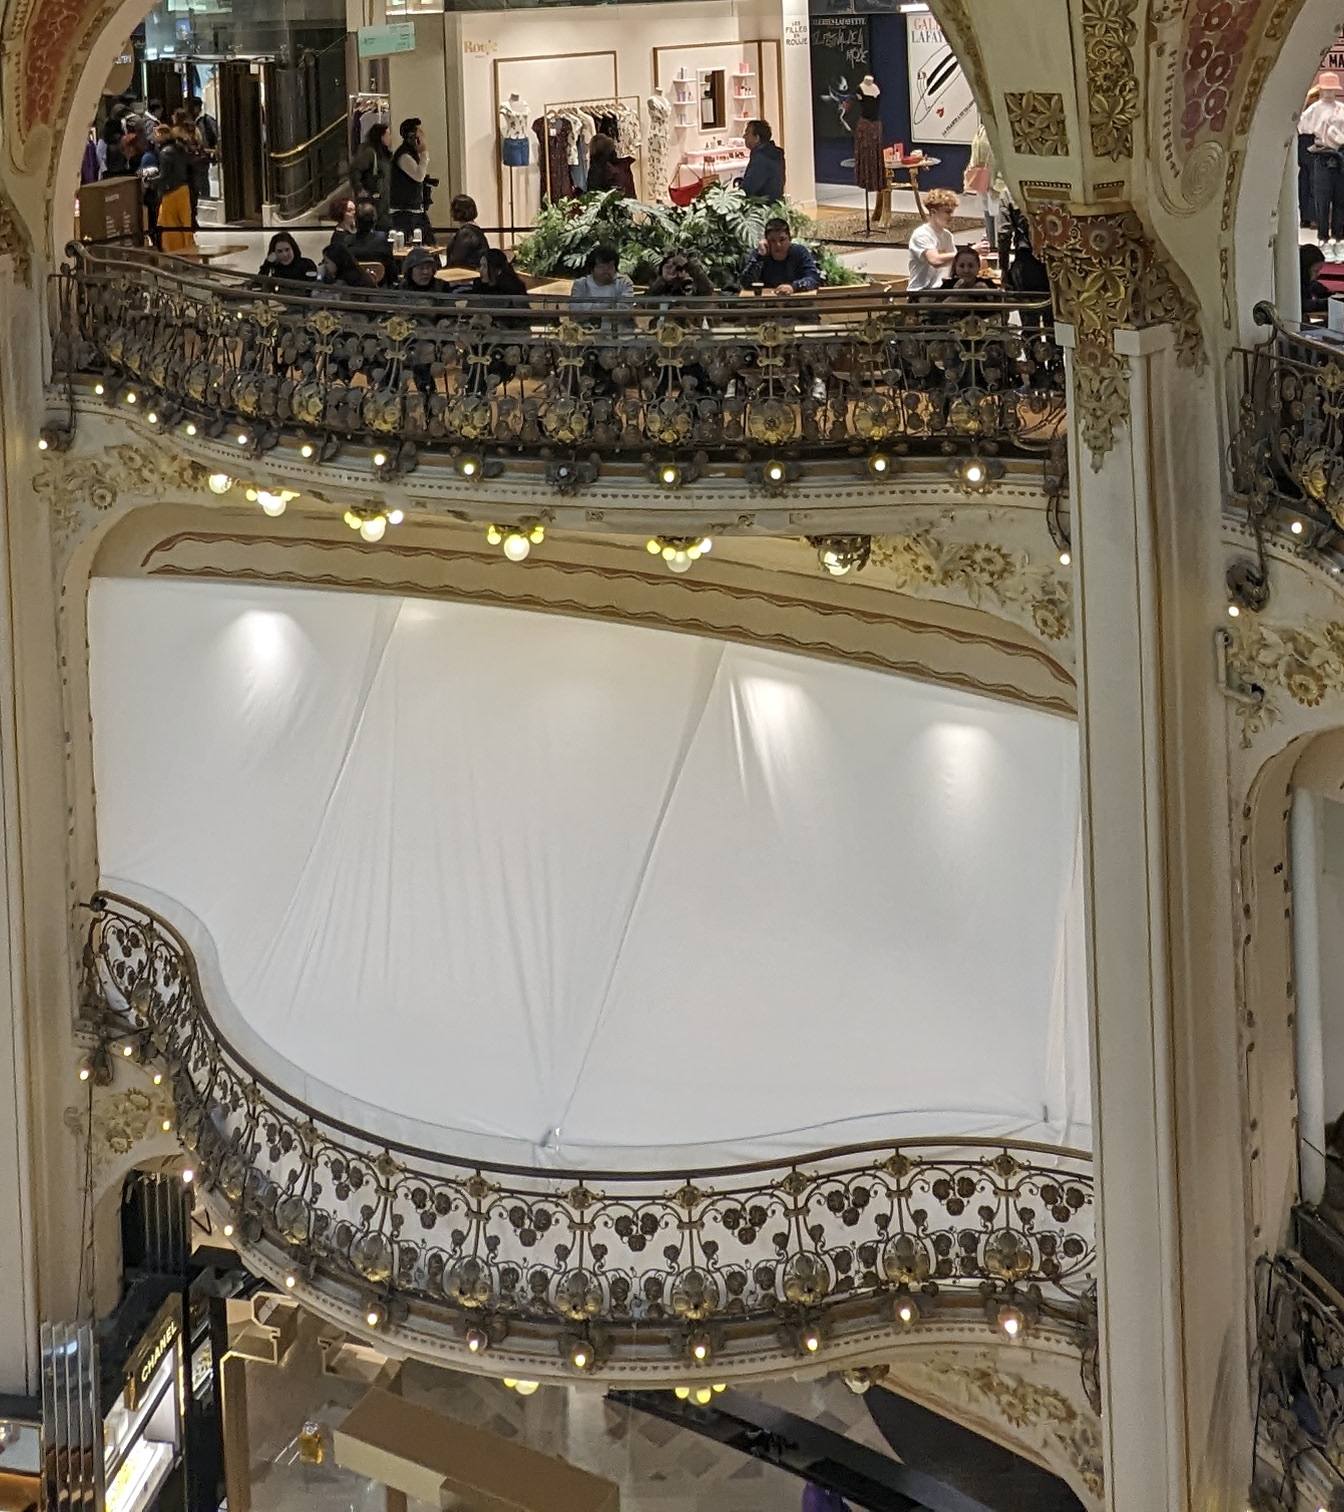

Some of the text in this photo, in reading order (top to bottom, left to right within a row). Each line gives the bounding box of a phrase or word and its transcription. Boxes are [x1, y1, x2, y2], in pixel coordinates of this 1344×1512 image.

[914, 17, 941, 31] GAL
[464, 39, 497, 55] Rouje
[140, 1321, 177, 1383] CHANEL
